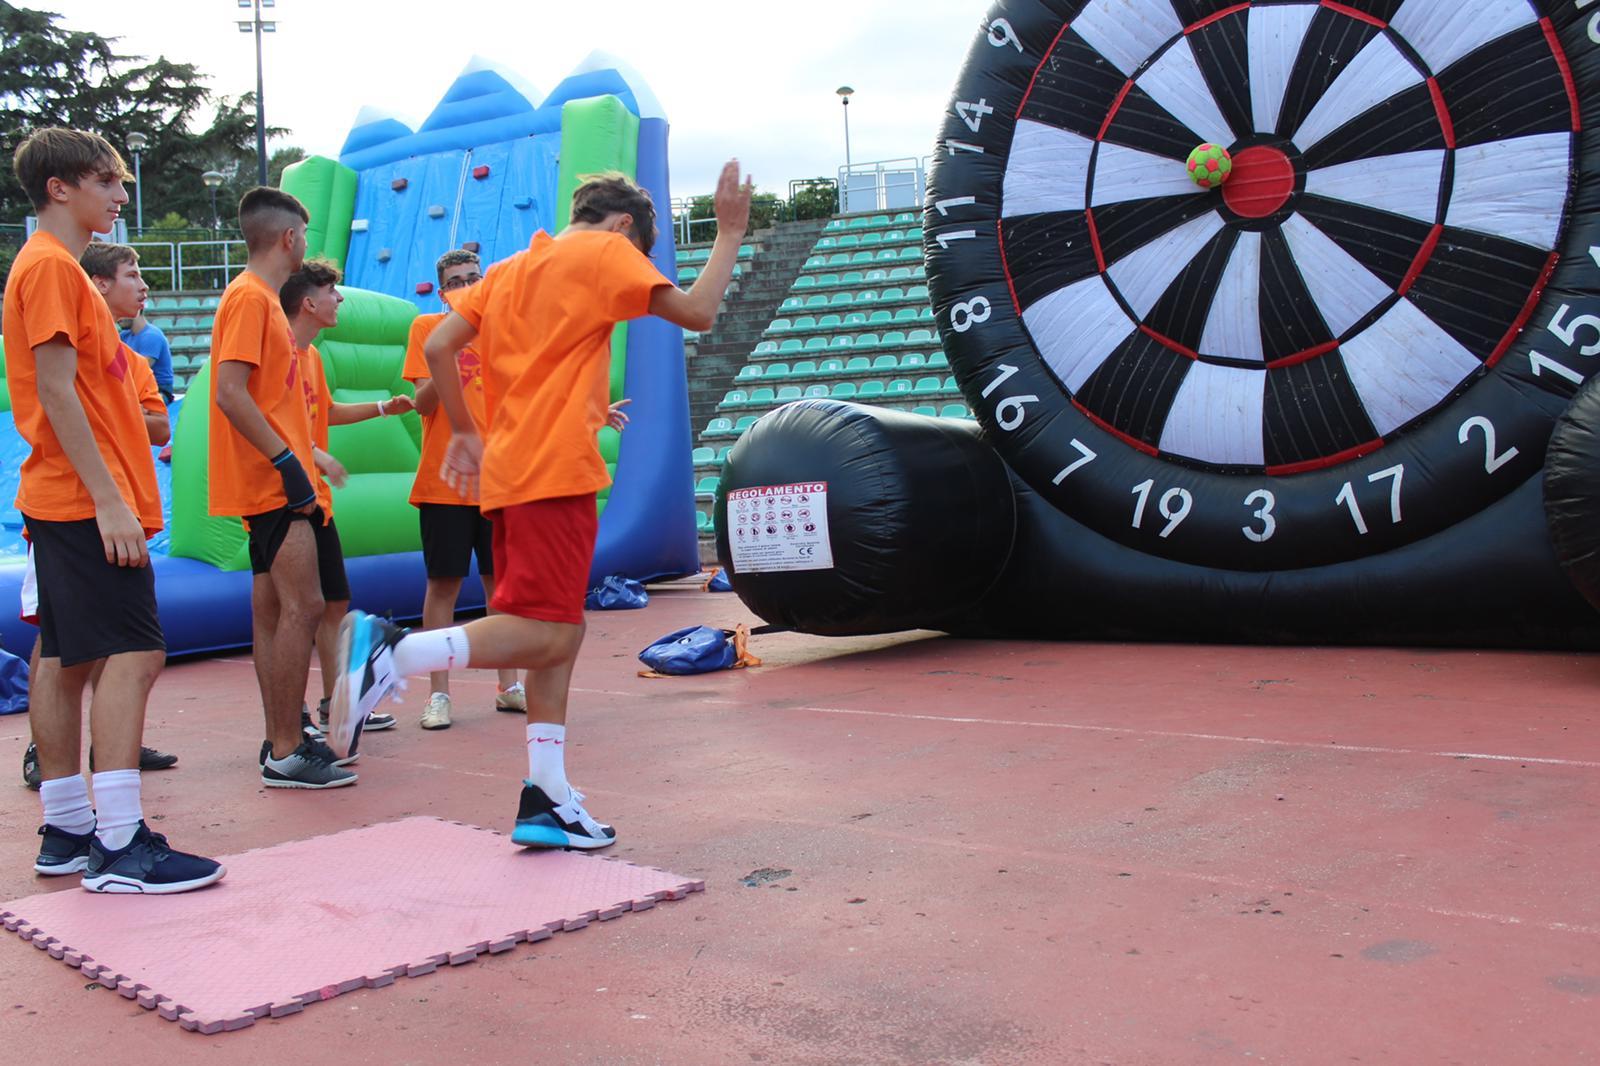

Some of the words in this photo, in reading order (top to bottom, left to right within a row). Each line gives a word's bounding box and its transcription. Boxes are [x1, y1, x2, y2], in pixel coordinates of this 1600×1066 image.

[987, 17, 1024, 53] 9
[945, 98, 994, 156] 14
[935, 195, 976, 249] 11
[951, 296, 992, 333] 8
[1528, 304, 1600, 385] 15
[981, 363, 1040, 432] 16
[1052, 438, 1098, 486] 7
[1458, 415, 1519, 475] 2
[729, 483, 825, 501] REGOLAMENTO
[1131, 478, 1193, 538] 19
[1242, 489, 1277, 542] 3
[1335, 463, 1405, 535] 17
